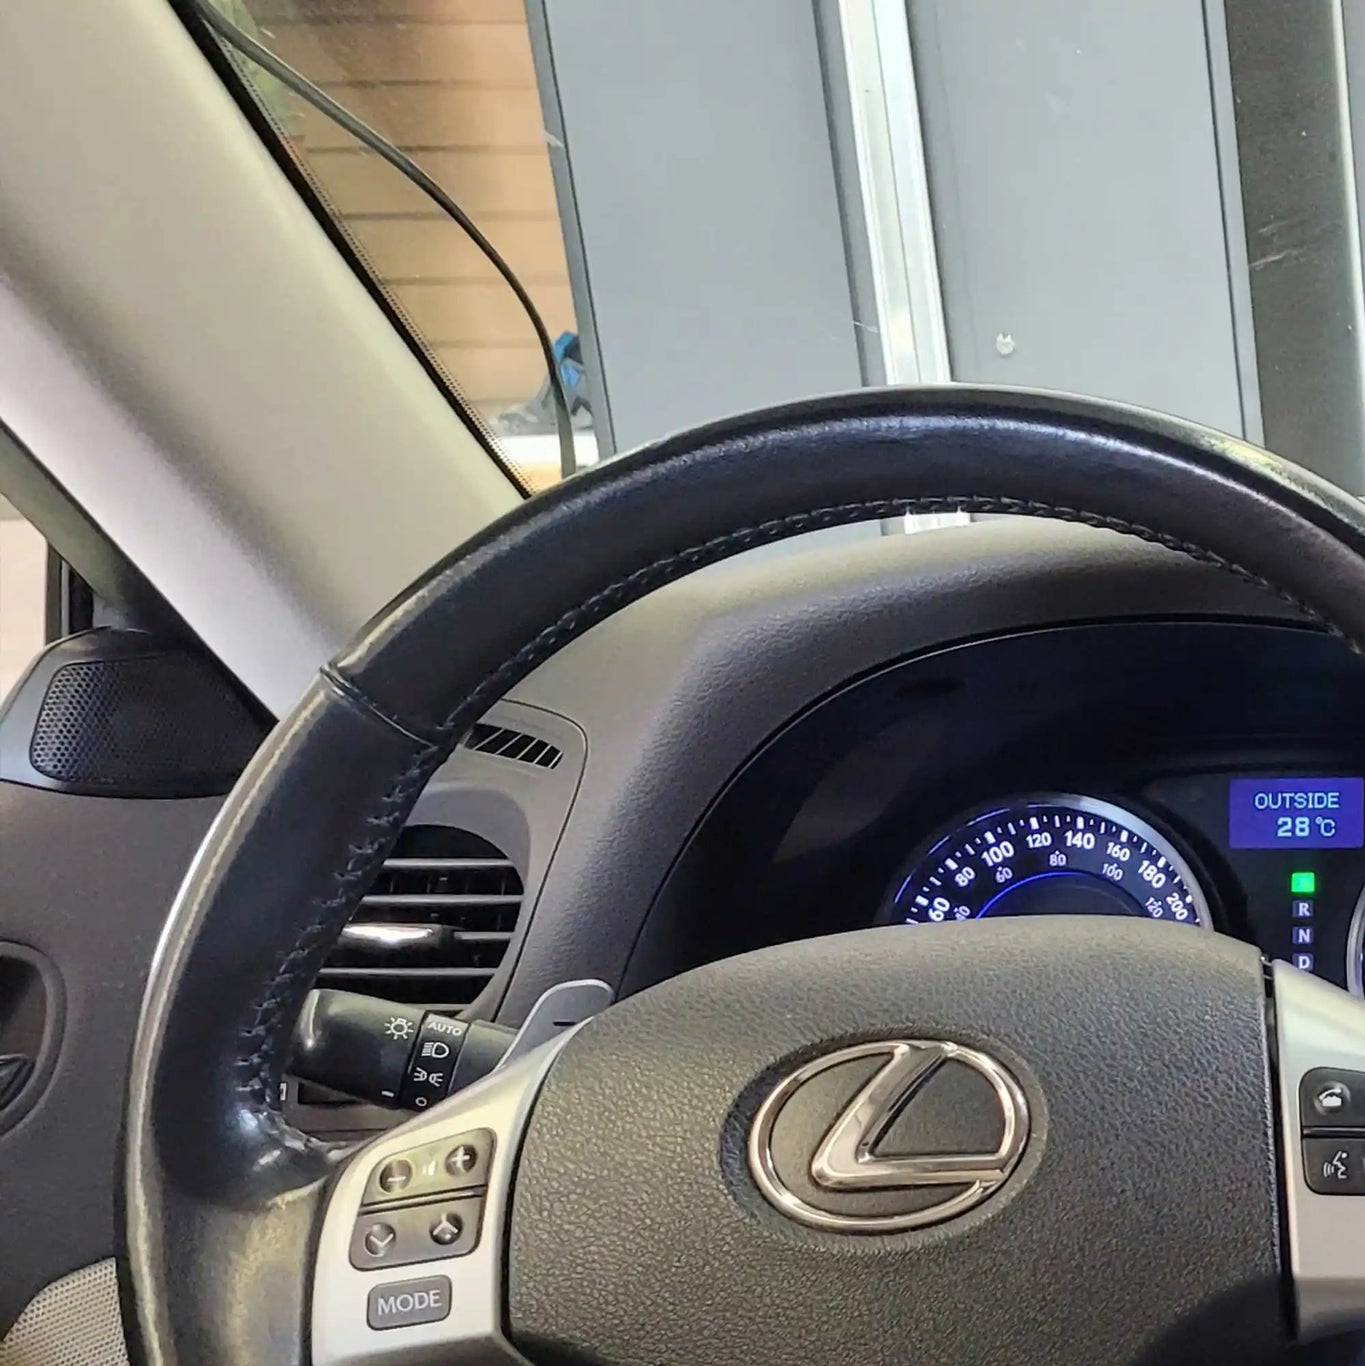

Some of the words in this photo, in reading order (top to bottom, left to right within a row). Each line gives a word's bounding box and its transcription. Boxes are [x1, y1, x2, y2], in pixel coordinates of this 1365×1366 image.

[1254, 792, 1340, 810] OUTSIDE
[1025, 831, 1052, 849] 120
[1063, 830, 1096, 850] 140
[981, 840, 1015, 867] 100
[1050, 853, 1067, 866] 80
[1106, 841, 1131, 862] 160
[954, 866, 976, 887] 80
[995, 868, 1014, 884] 60
[1102, 865, 1123, 882] 100
[1137, 860, 1167, 889] 180
[928, 897, 951, 922] 60
[1145, 897, 1164, 919] 120
[1166, 892, 1189, 921] 200
[1298, 903, 1311, 917] R
[1298, 929, 1311, 943] N
[1298, 956, 1311, 969] D
[427, 1021, 463, 1037] AUTO
[378, 1289, 443, 1316] MODE
